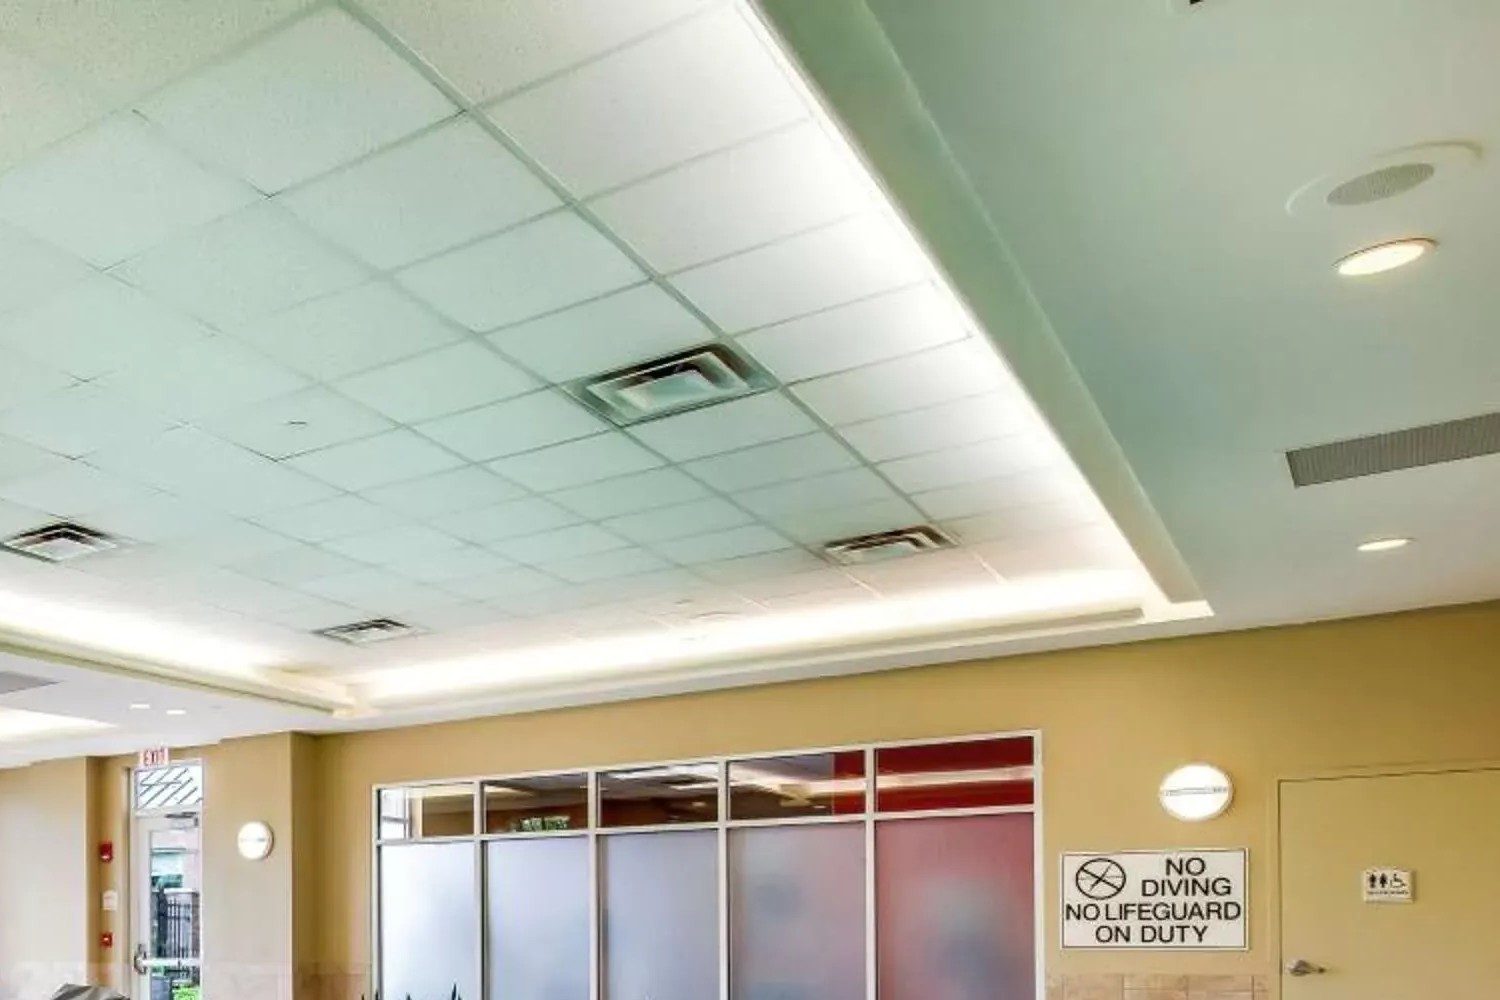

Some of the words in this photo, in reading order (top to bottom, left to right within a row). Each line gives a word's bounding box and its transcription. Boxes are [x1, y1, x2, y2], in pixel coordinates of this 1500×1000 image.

[1165, 857, 1206, 877] NO
[1141, 877, 1232, 897] DIVING
[1065, 903, 1100, 921] NO
[1105, 901, 1241, 921] LIFEGUARD
[1095, 925, 1131, 943] ON
[1141, 925, 1208, 943] DUTY
